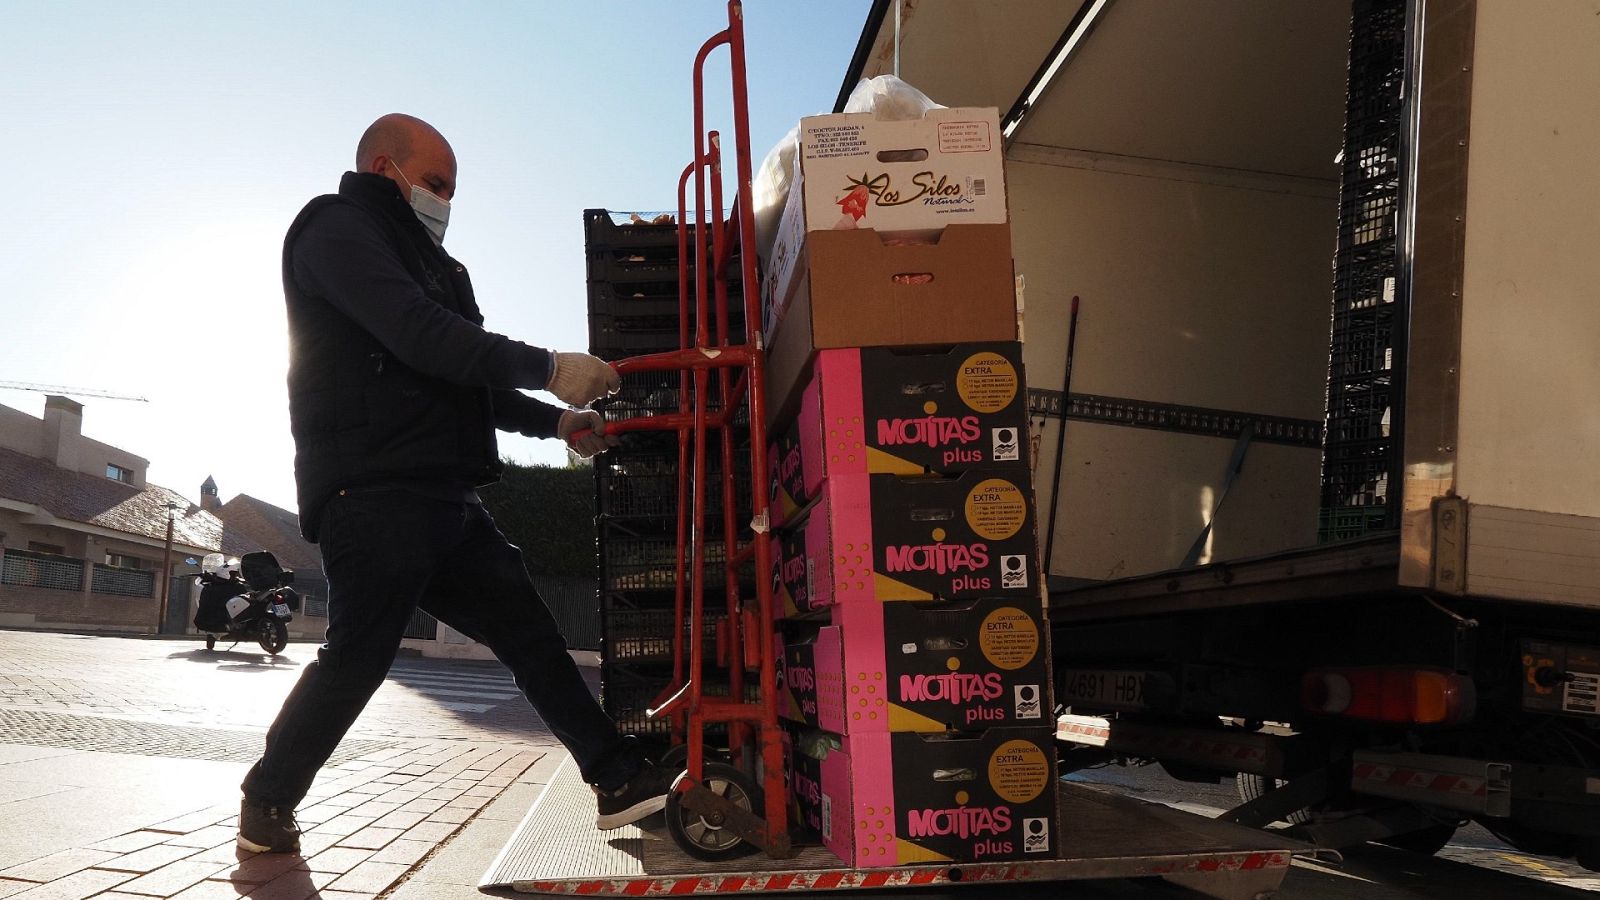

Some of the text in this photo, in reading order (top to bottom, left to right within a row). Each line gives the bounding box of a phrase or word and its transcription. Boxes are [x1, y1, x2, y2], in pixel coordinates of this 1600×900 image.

[912, 172, 960, 196] Silos
[877, 416, 981, 448] MOTITAS
[944, 448, 982, 466] plus
[886, 542, 989, 575] MOTITAS
[952, 575, 991, 594] plus
[900, 672, 1003, 704] MOTITAS
[1070, 672, 1104, 701] 4691
[966, 705, 1005, 724] plus
[908, 806, 1012, 839] MOTITAS
[975, 839, 1013, 859] plus
